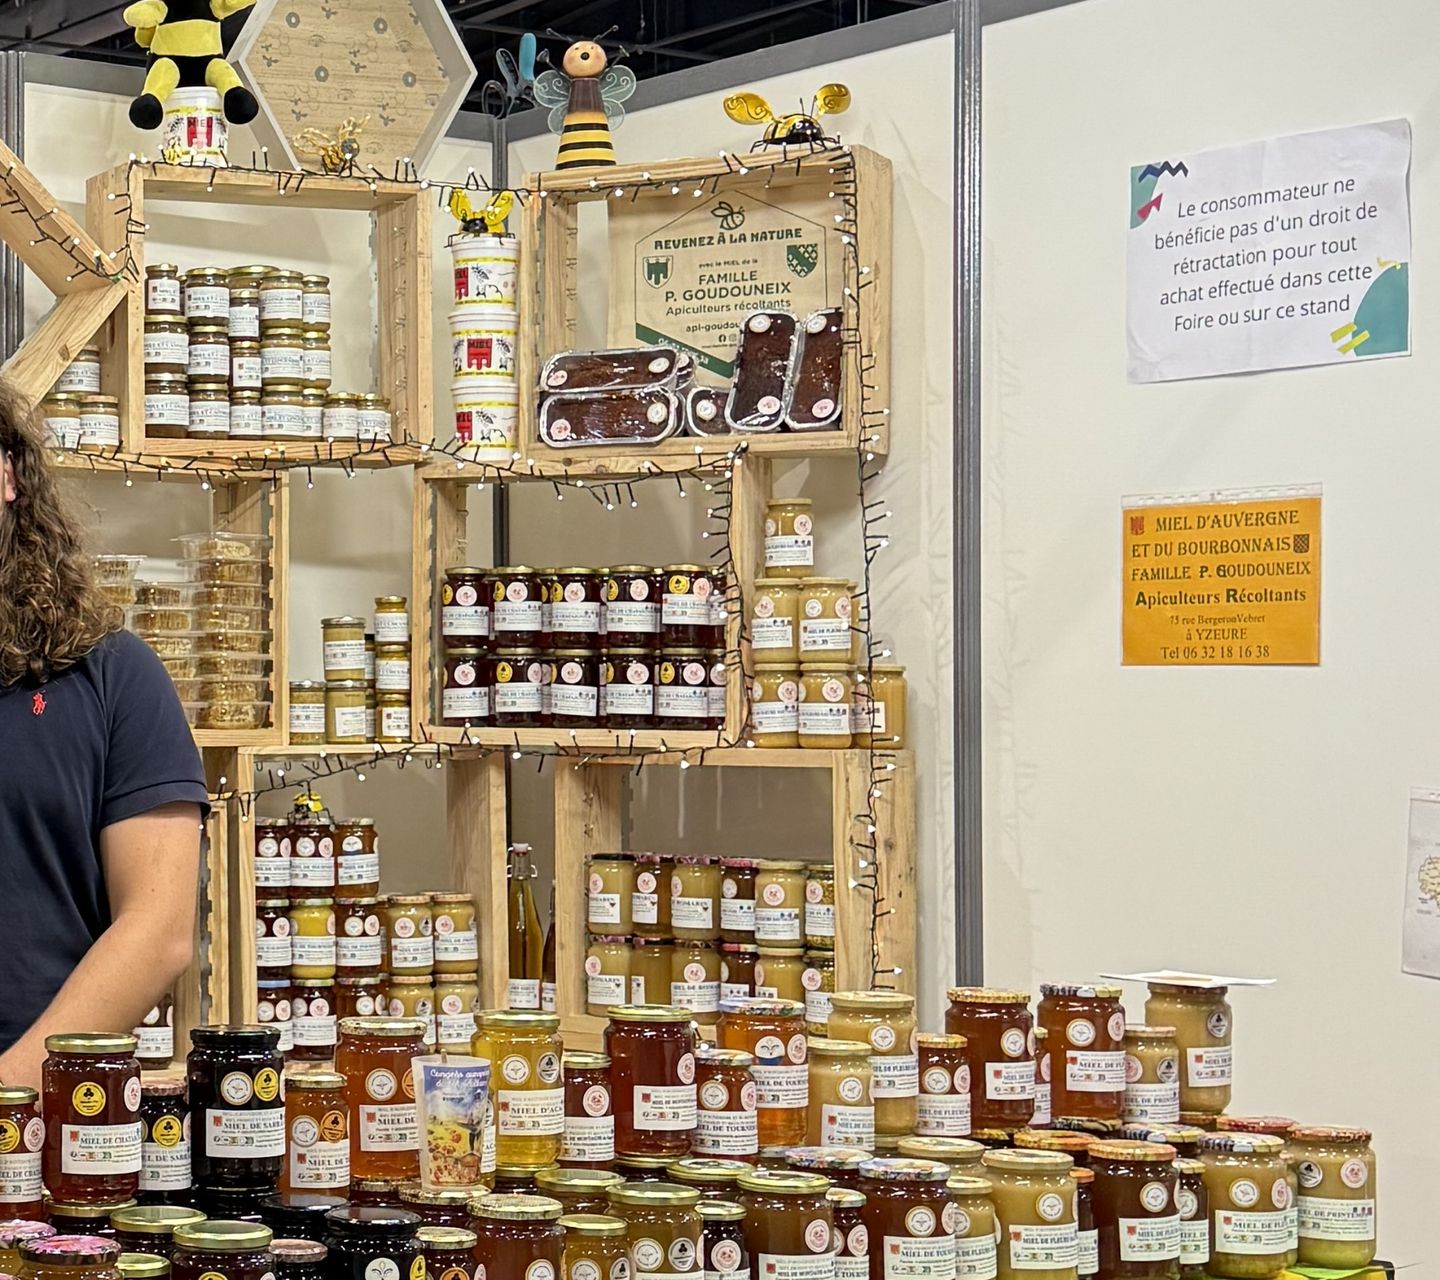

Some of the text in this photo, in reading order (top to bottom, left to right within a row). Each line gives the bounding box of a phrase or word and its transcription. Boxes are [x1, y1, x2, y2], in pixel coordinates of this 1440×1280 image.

[1178, 178, 1355, 218] Le consommateur ne
[1155, 203, 1377, 250] bénéficie pas d'un droit de
[654, 228, 802, 250] REVENEZ À LA NATURE
[1174, 237, 1357, 275] rétractation pour tout
[699, 270, 758, 285] FAMILLE
[1160, 265, 1372, 305] achat effectué dans cette
[665, 282, 791, 302] P. GOUDOUNEIX
[666, 298, 791, 316] Apiculteurs récoltants
[1175, 294, 1350, 332] Foire ou sur ce stand
[1156, 510, 1300, 532] MIEL D'AUVERGNE
[1132, 537, 1290, 558] ET DU BOURBONNAIS
[1132, 561, 1311, 581] FAMILLE P. GOUDOUNEIX
[1136, 588, 1306, 609] Apiculteurs Récoltants
[1186, 628, 1247, 641] à YZEURE
[1161, 645, 1270, 659] Tel 06 32 18 16 38
